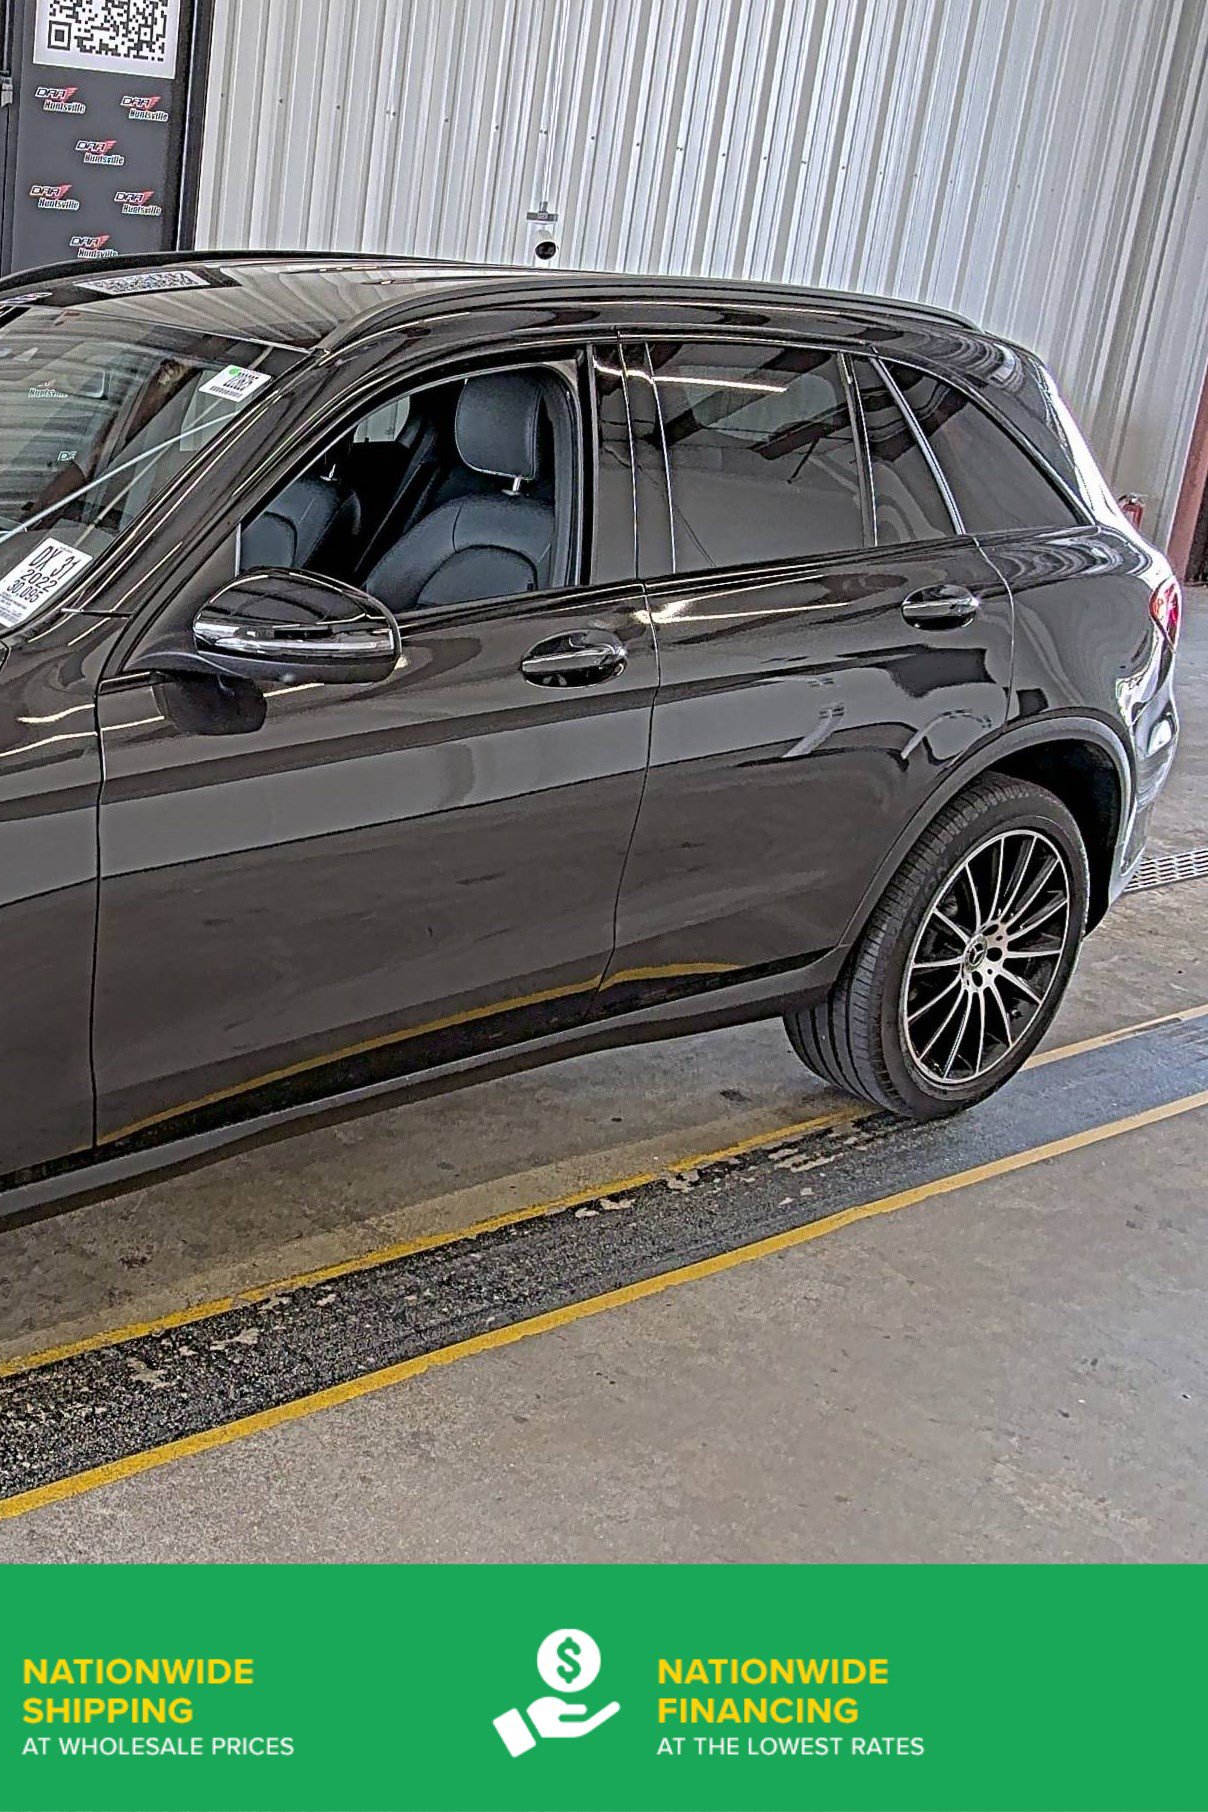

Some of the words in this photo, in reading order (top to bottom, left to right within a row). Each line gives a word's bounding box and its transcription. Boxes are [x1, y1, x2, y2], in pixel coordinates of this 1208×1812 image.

[28, 546, 63, 572] DX
[50, 555, 82, 580] 31
[20, 569, 58, 593] 2022
